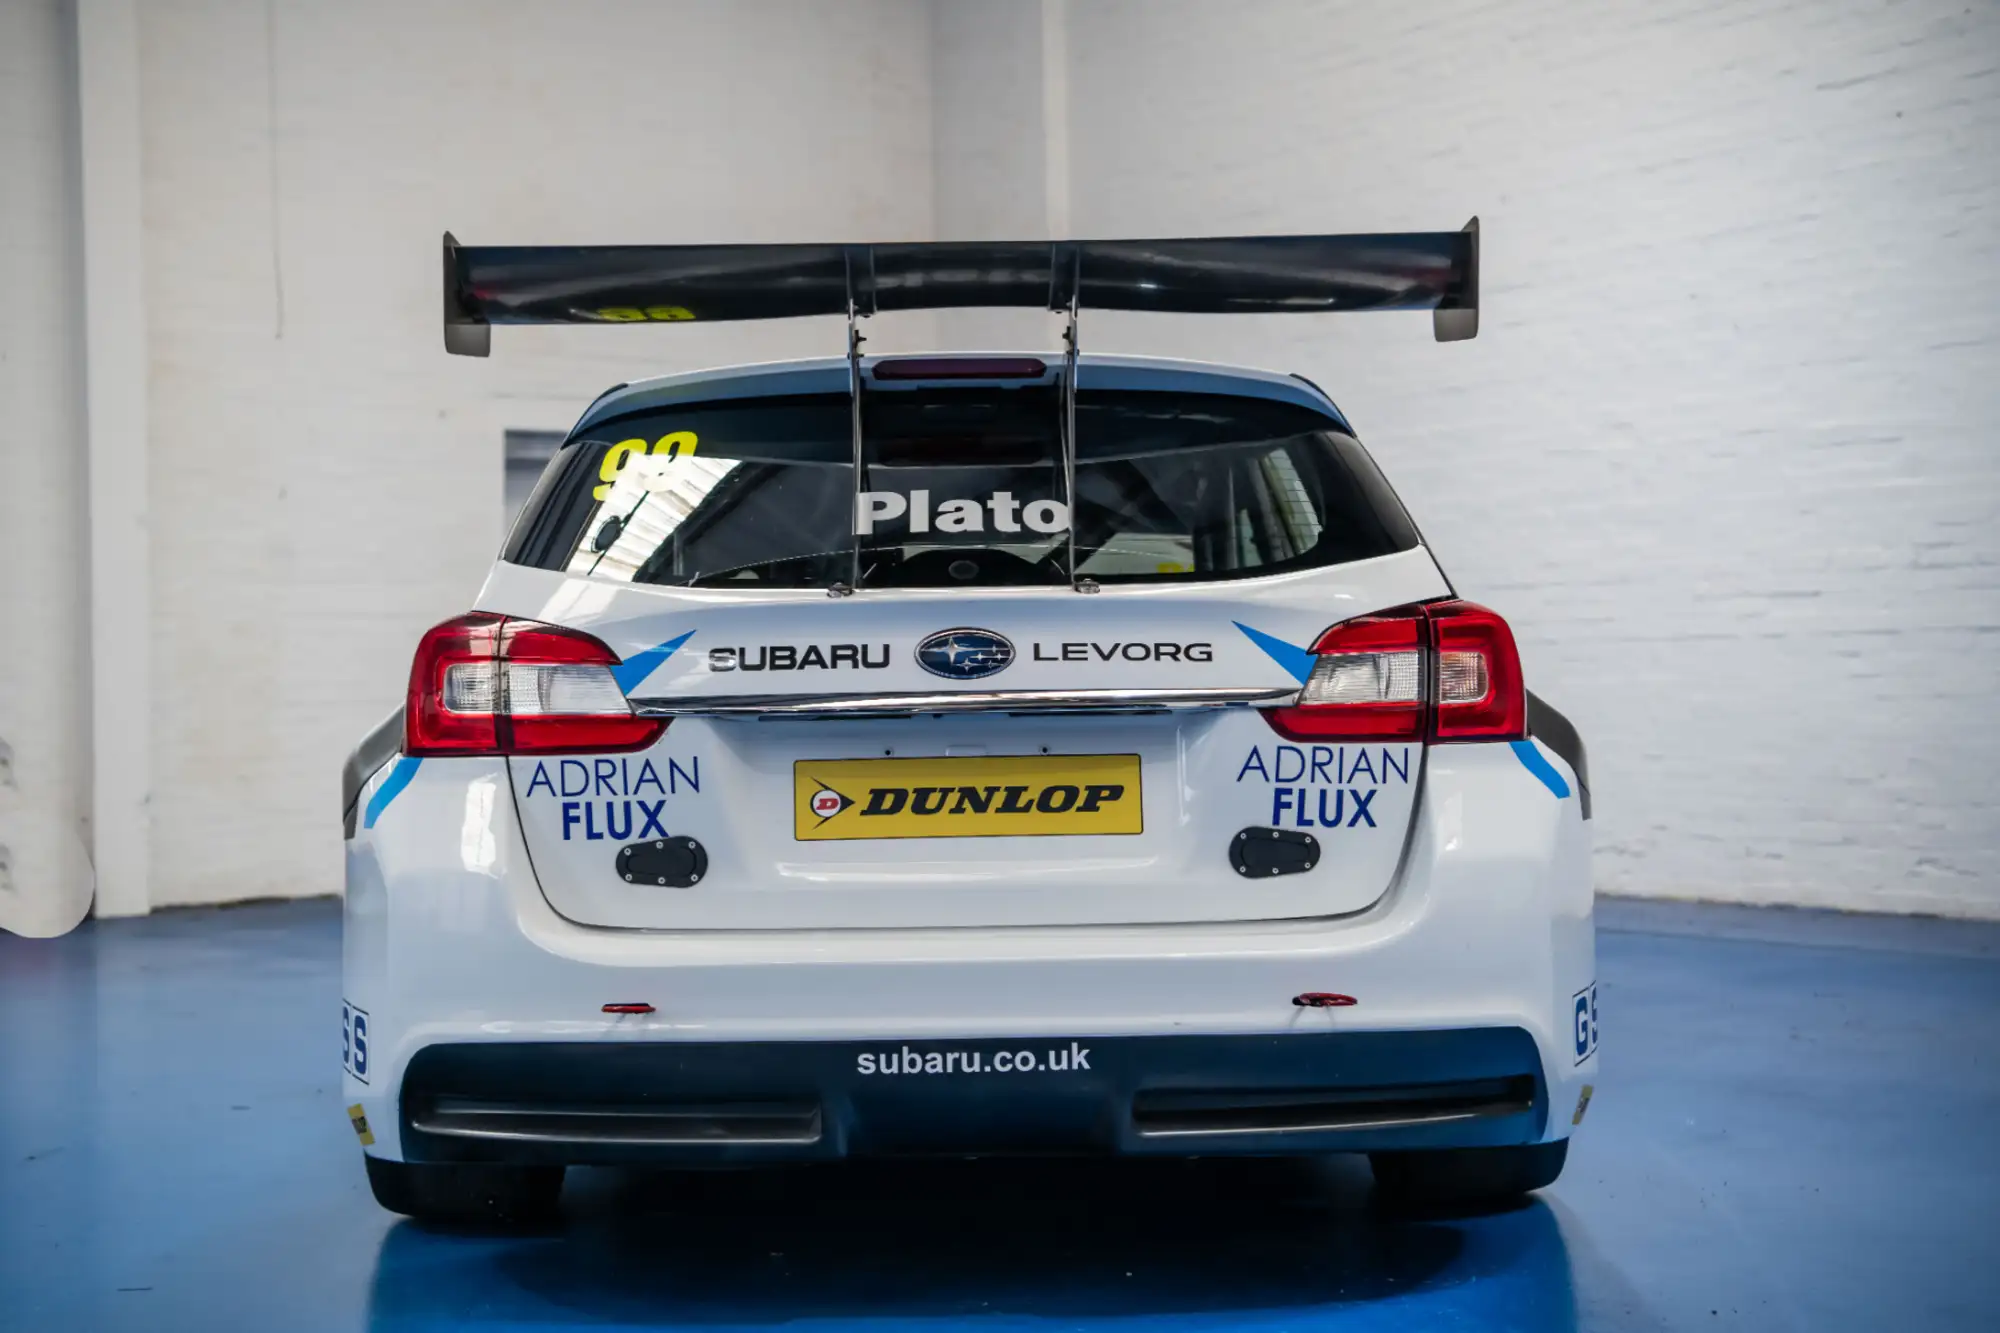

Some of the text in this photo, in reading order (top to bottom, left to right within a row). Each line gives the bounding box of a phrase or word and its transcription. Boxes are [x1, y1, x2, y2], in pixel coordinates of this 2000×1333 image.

[854, 489, 1070, 535] Plato
[708, 642, 1213, 672] SUBARU LEVORG
[526, 756, 700, 797] ADRIAN
[1236, 745, 1408, 784] ADRIAN
[815, 797, 839, 810] D
[860, 784, 1124, 816] DUNLOP
[1272, 788, 1377, 828] FLUX
[562, 800, 669, 840] FLUX
[857, 1042, 1091, 1074] subaru.co.uk
